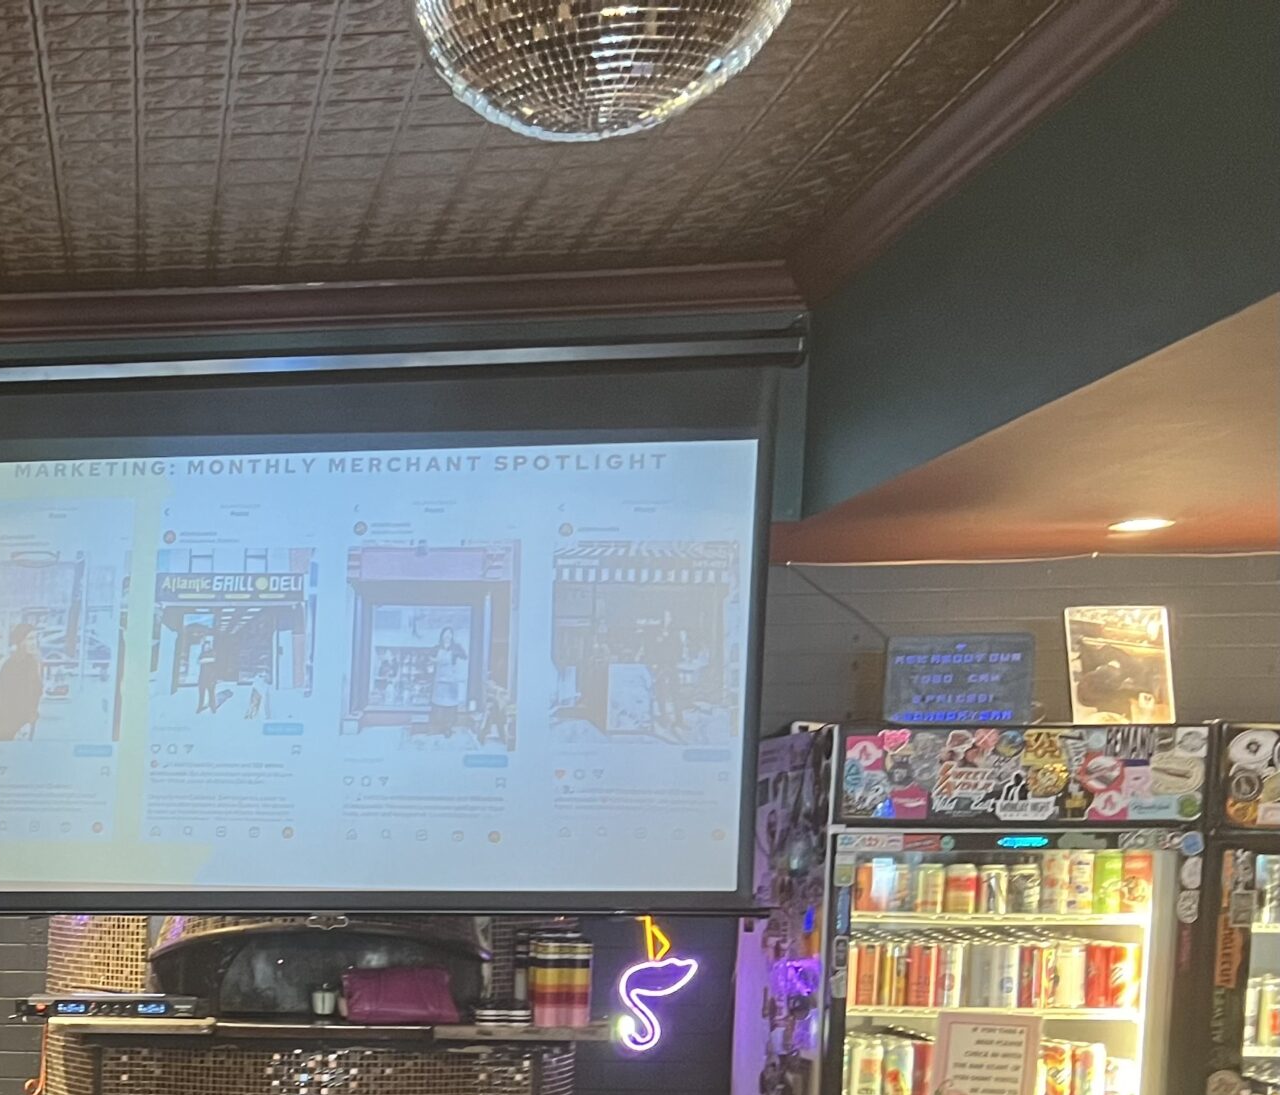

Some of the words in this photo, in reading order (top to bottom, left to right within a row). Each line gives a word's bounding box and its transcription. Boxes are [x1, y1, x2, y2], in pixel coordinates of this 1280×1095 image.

[14, 460, 177, 478] MARKETING:
[187, 458, 317, 475] MONTHLY
[327, 455, 483, 474] MERCHANT
[493, 452, 669, 471] SPOTLIGHT
[213, 575, 255, 592] GRILL
[270, 575, 303, 592] DELI
